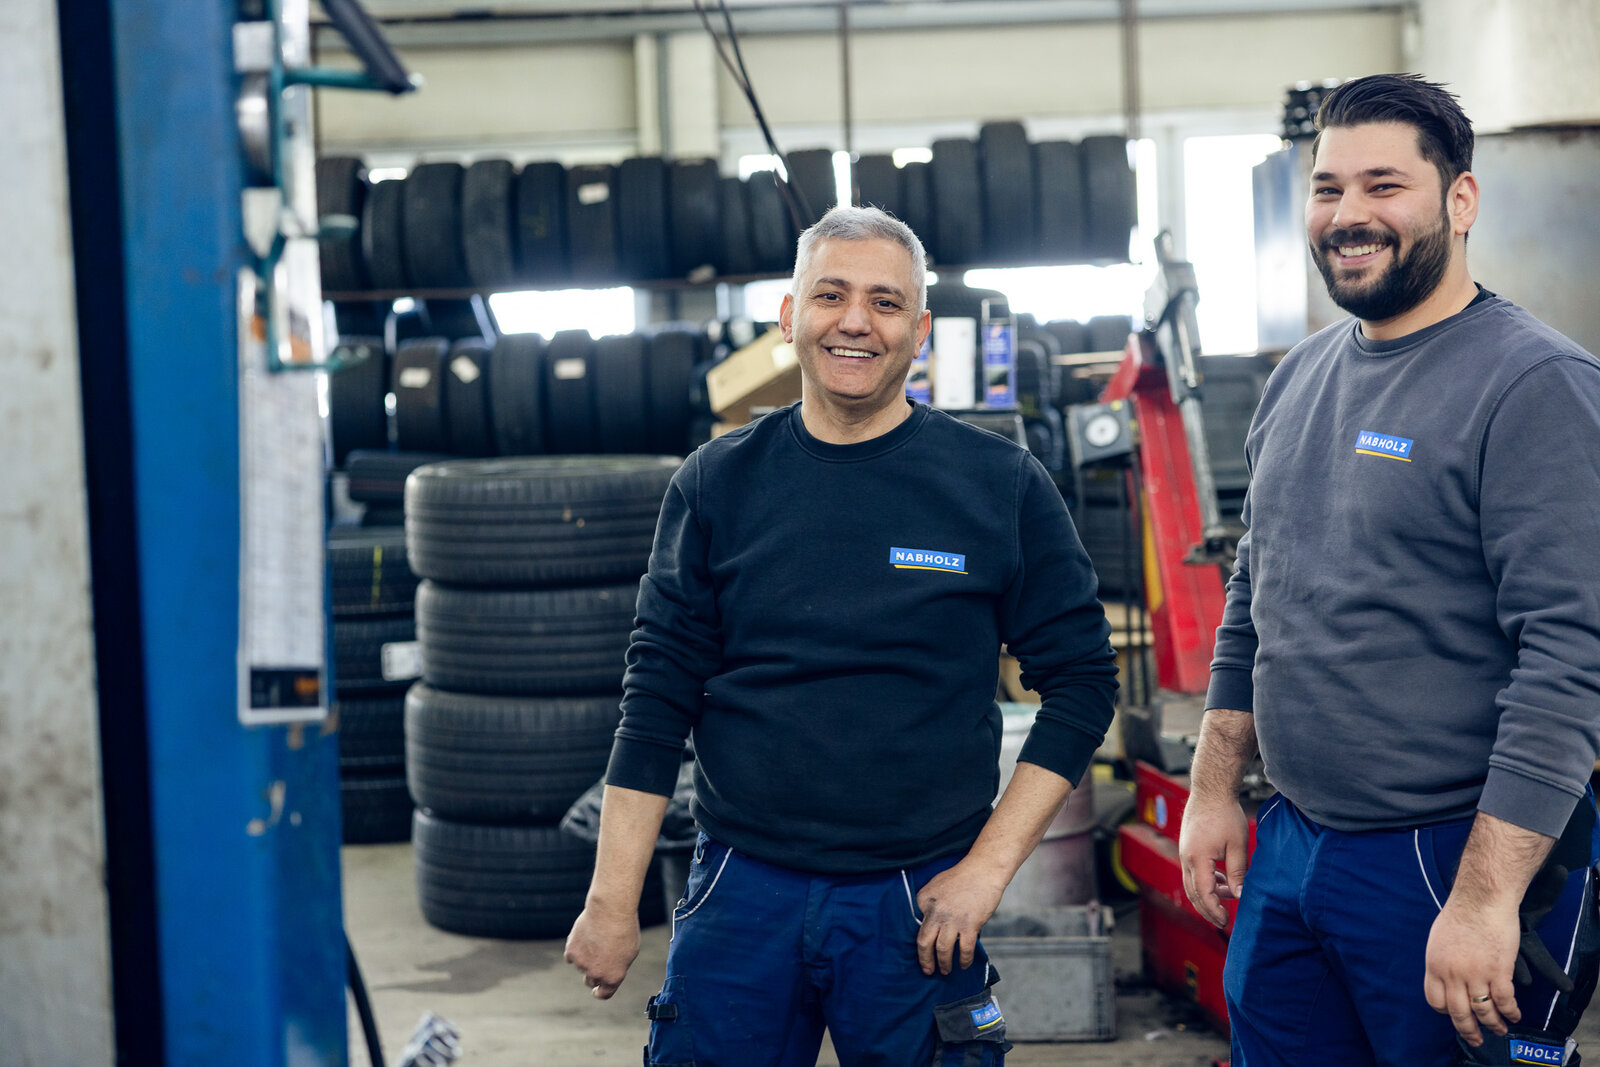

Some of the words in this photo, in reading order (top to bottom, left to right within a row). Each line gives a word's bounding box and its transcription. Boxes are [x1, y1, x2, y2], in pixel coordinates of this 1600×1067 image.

[1360, 434, 1408, 453] NABHOLZ
[895, 551, 960, 567] NABHOLZ
[1515, 1044, 1561, 1061] BHOLZ
